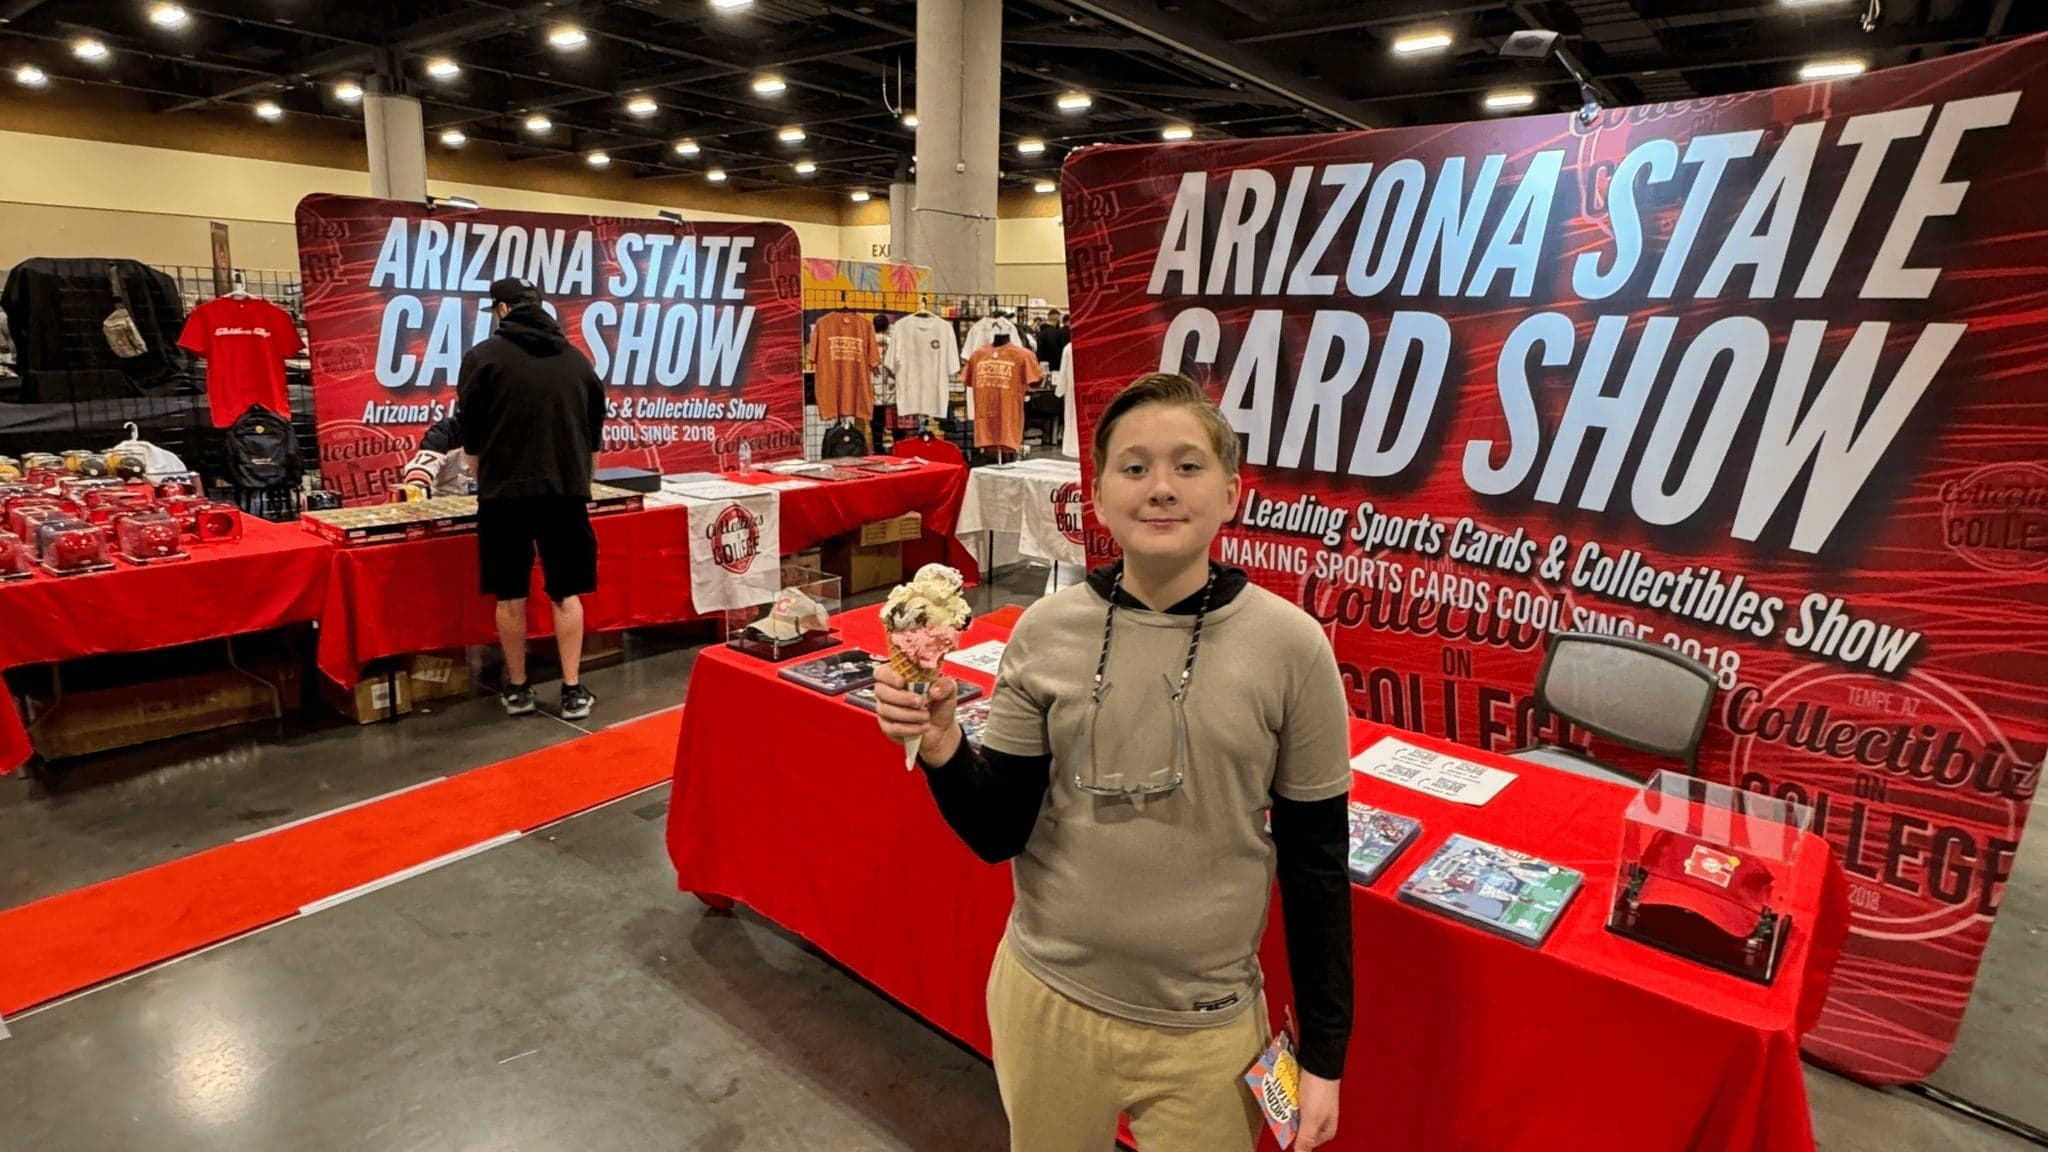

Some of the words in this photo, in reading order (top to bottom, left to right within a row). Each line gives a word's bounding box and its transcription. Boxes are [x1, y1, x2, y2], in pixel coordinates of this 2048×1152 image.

[1147, 148, 1566, 298] ARIZONA
[1571, 90, 2022, 300] STATE
[369, 217, 593, 295] ARIZONA
[608, 233, 756, 300] STATE
[375, 295, 557, 388] CA
[582, 301, 757, 387] SHOW
[362, 400, 444, 424] Arizona's
[602, 425, 637, 441] COOL
[640, 425, 679, 442] SINCE
[682, 426, 716, 442] 2018
[620, 397, 633, 418] &
[636, 397, 725, 420] Collectibles
[726, 398, 767, 421] Show
[1462, 311, 1968, 554] SHOW
[1221, 536, 1308, 575] MAKING
[1314, 549, 1403, 594] SPORTS
[1409, 567, 1491, 614] CARDS
[1496, 586, 1562, 634] COOL
[1242, 489, 1349, 546] Leading
[1350, 502, 1444, 555] Sports
[1449, 517, 1538, 574] Cards
[1540, 535, 1569, 578] &
[1572, 539, 1785, 638] Collectibles
[1786, 592, 1923, 673] Show
[1442, 646, 1473, 679] ON
[1849, 884, 1882, 912] 2018
